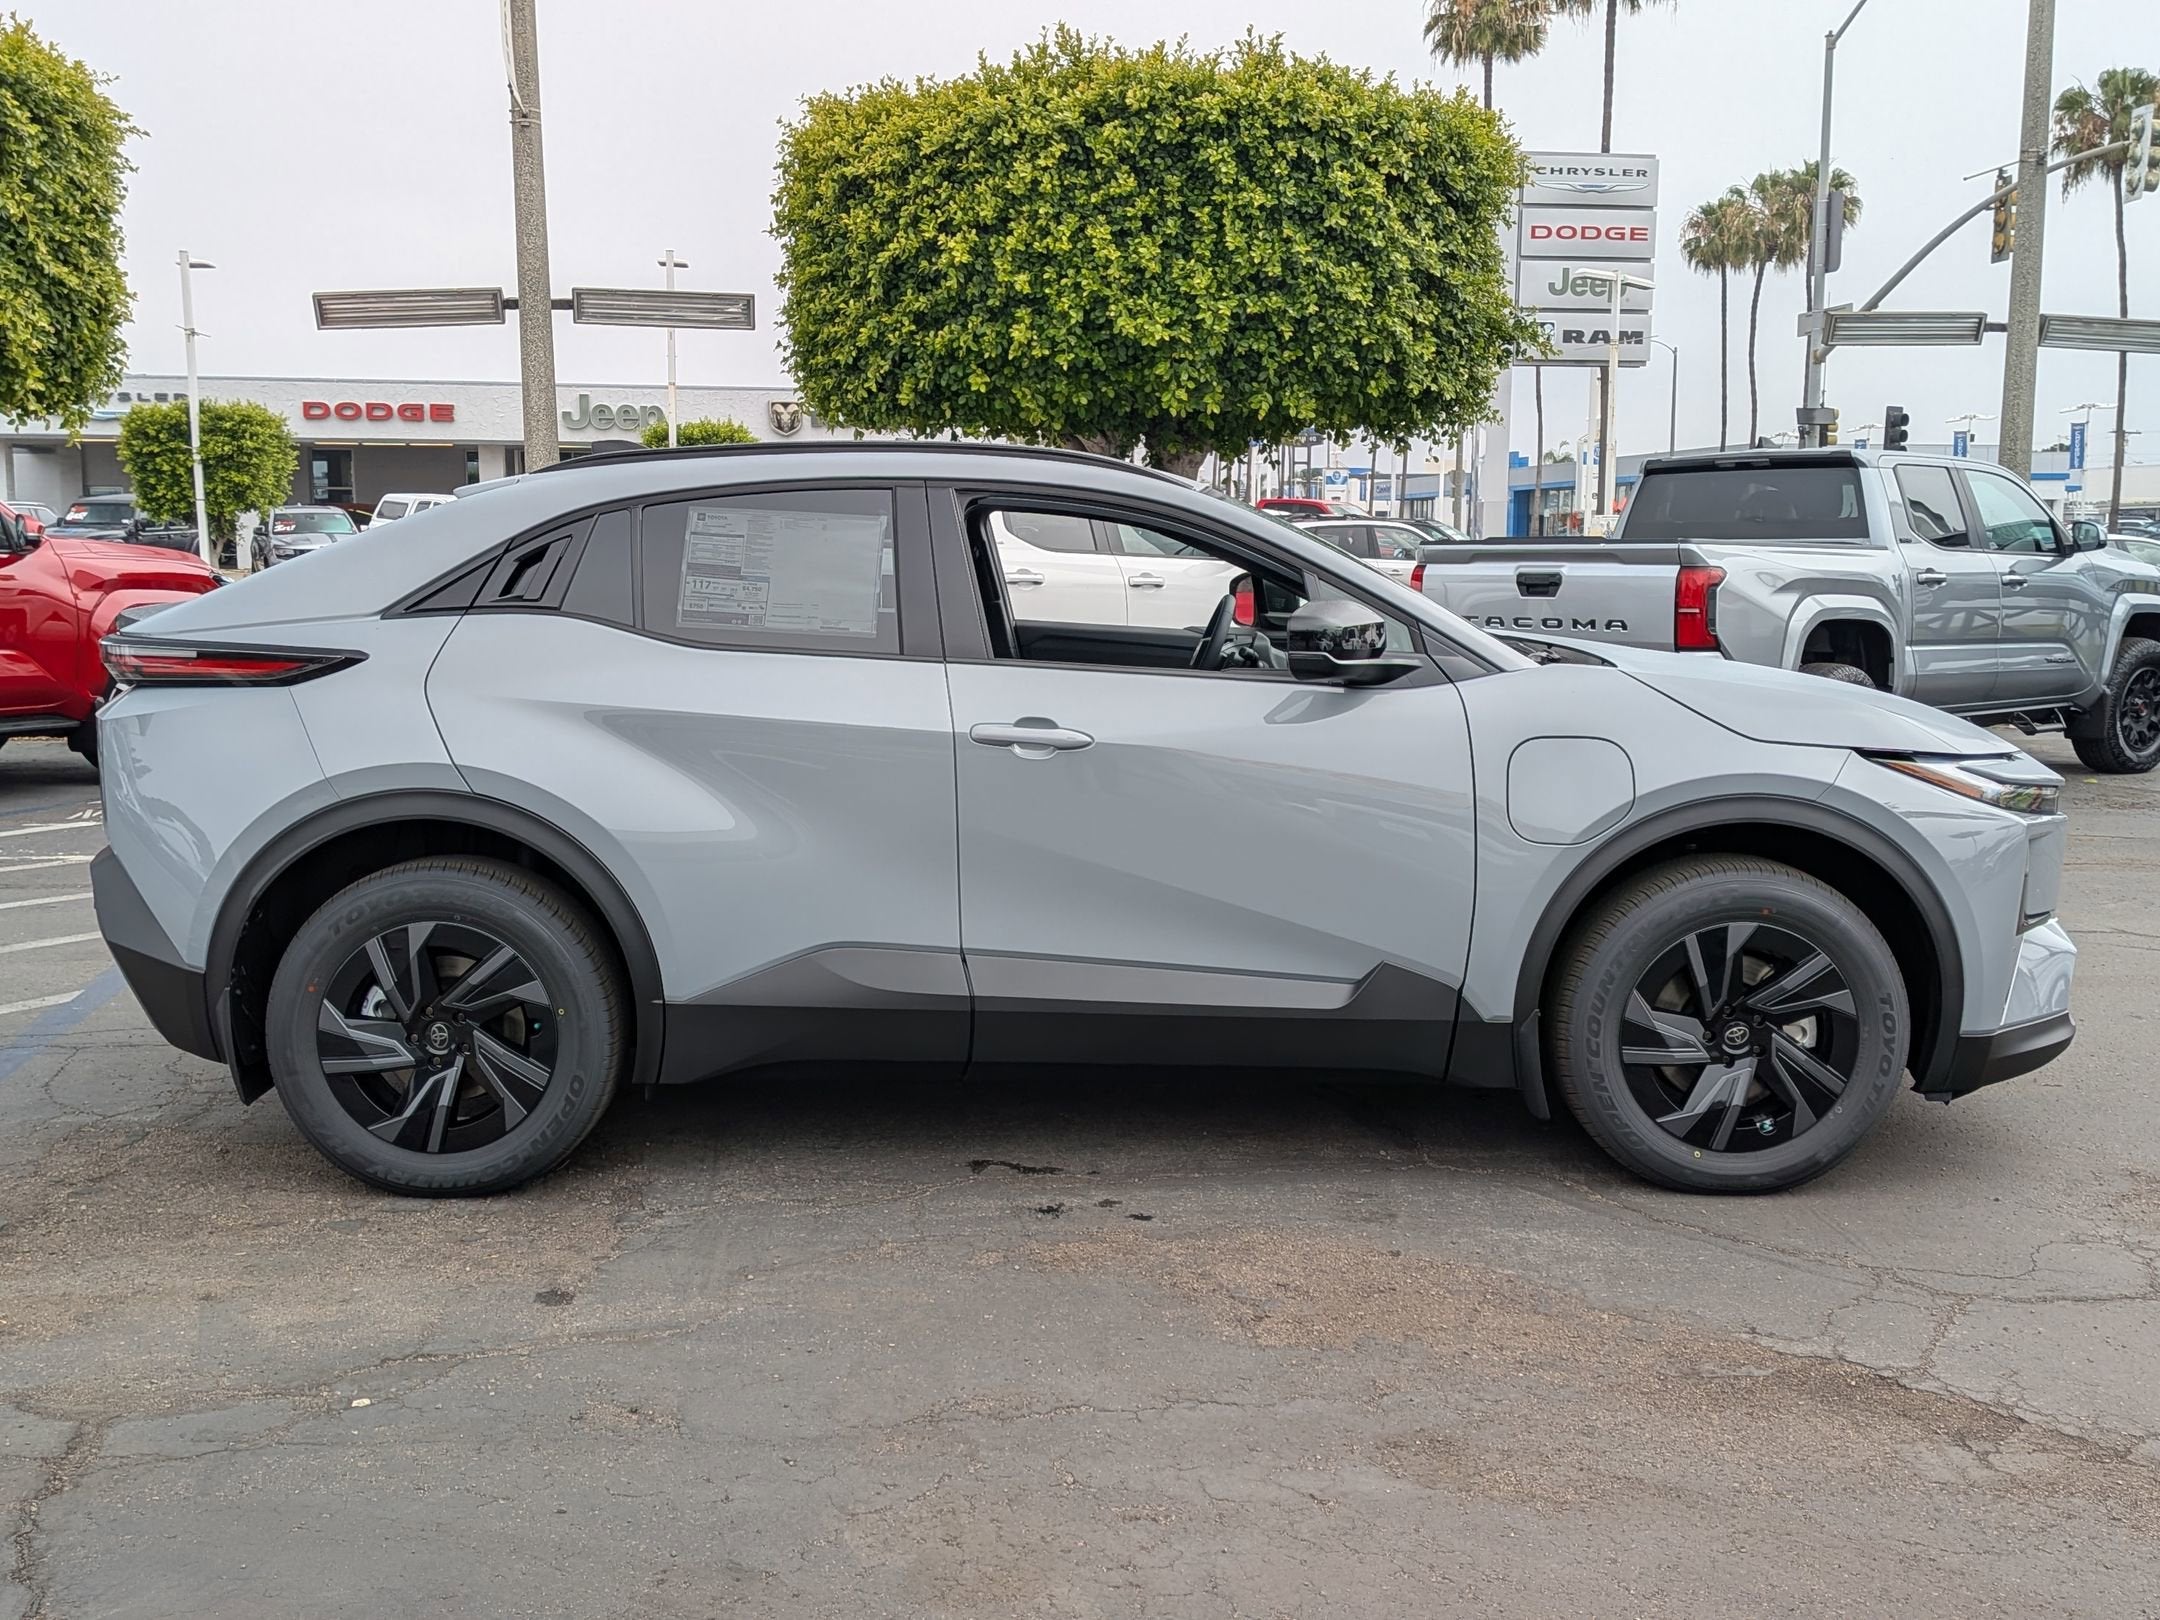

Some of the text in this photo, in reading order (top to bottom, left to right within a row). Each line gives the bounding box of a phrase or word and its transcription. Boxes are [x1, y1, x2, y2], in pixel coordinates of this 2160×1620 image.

[1535, 166, 1648, 178] CHRYSLER
[1530, 225, 1649, 241] DODGE
[1562, 329, 1644, 345] RAM
[302, 401, 455, 423] DODGE
[691, 579, 712, 590] 117
[1878, 992, 1897, 1078] TOYO
[527, 1073, 587, 1152] OPEN
